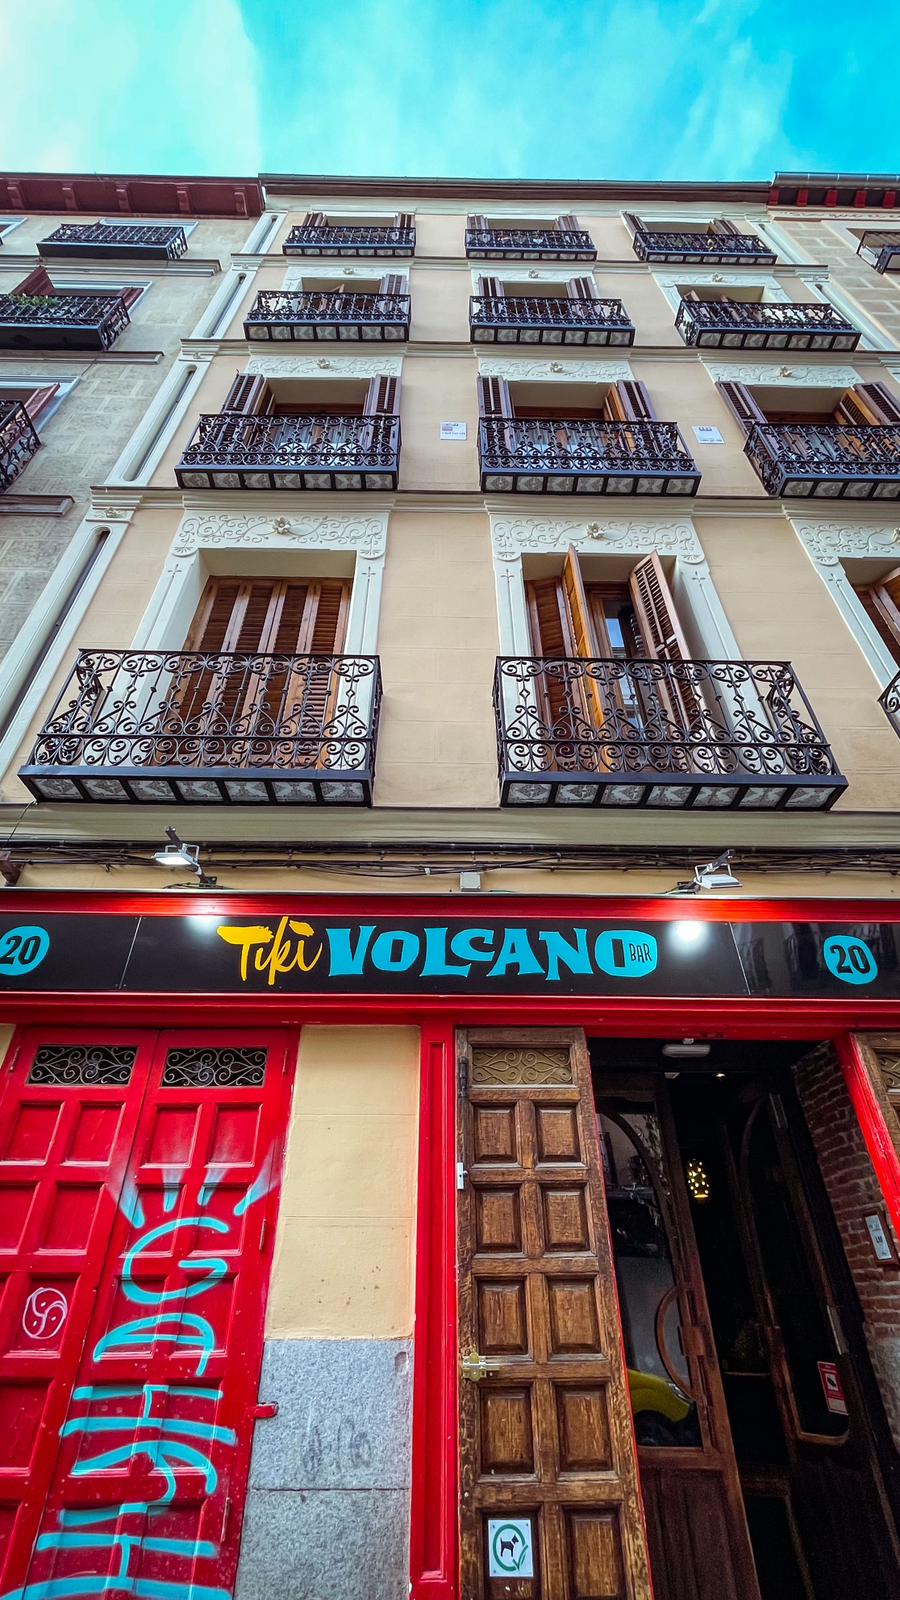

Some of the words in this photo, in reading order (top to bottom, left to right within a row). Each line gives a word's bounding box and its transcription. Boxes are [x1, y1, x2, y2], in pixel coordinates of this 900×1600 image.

[0, 935, 41, 965] 20
[216, 916, 324, 986] Tiki
[325, 925, 658, 981] VOLCANO
[629, 943, 653, 963] BAR
[830, 944, 872, 975] 20
